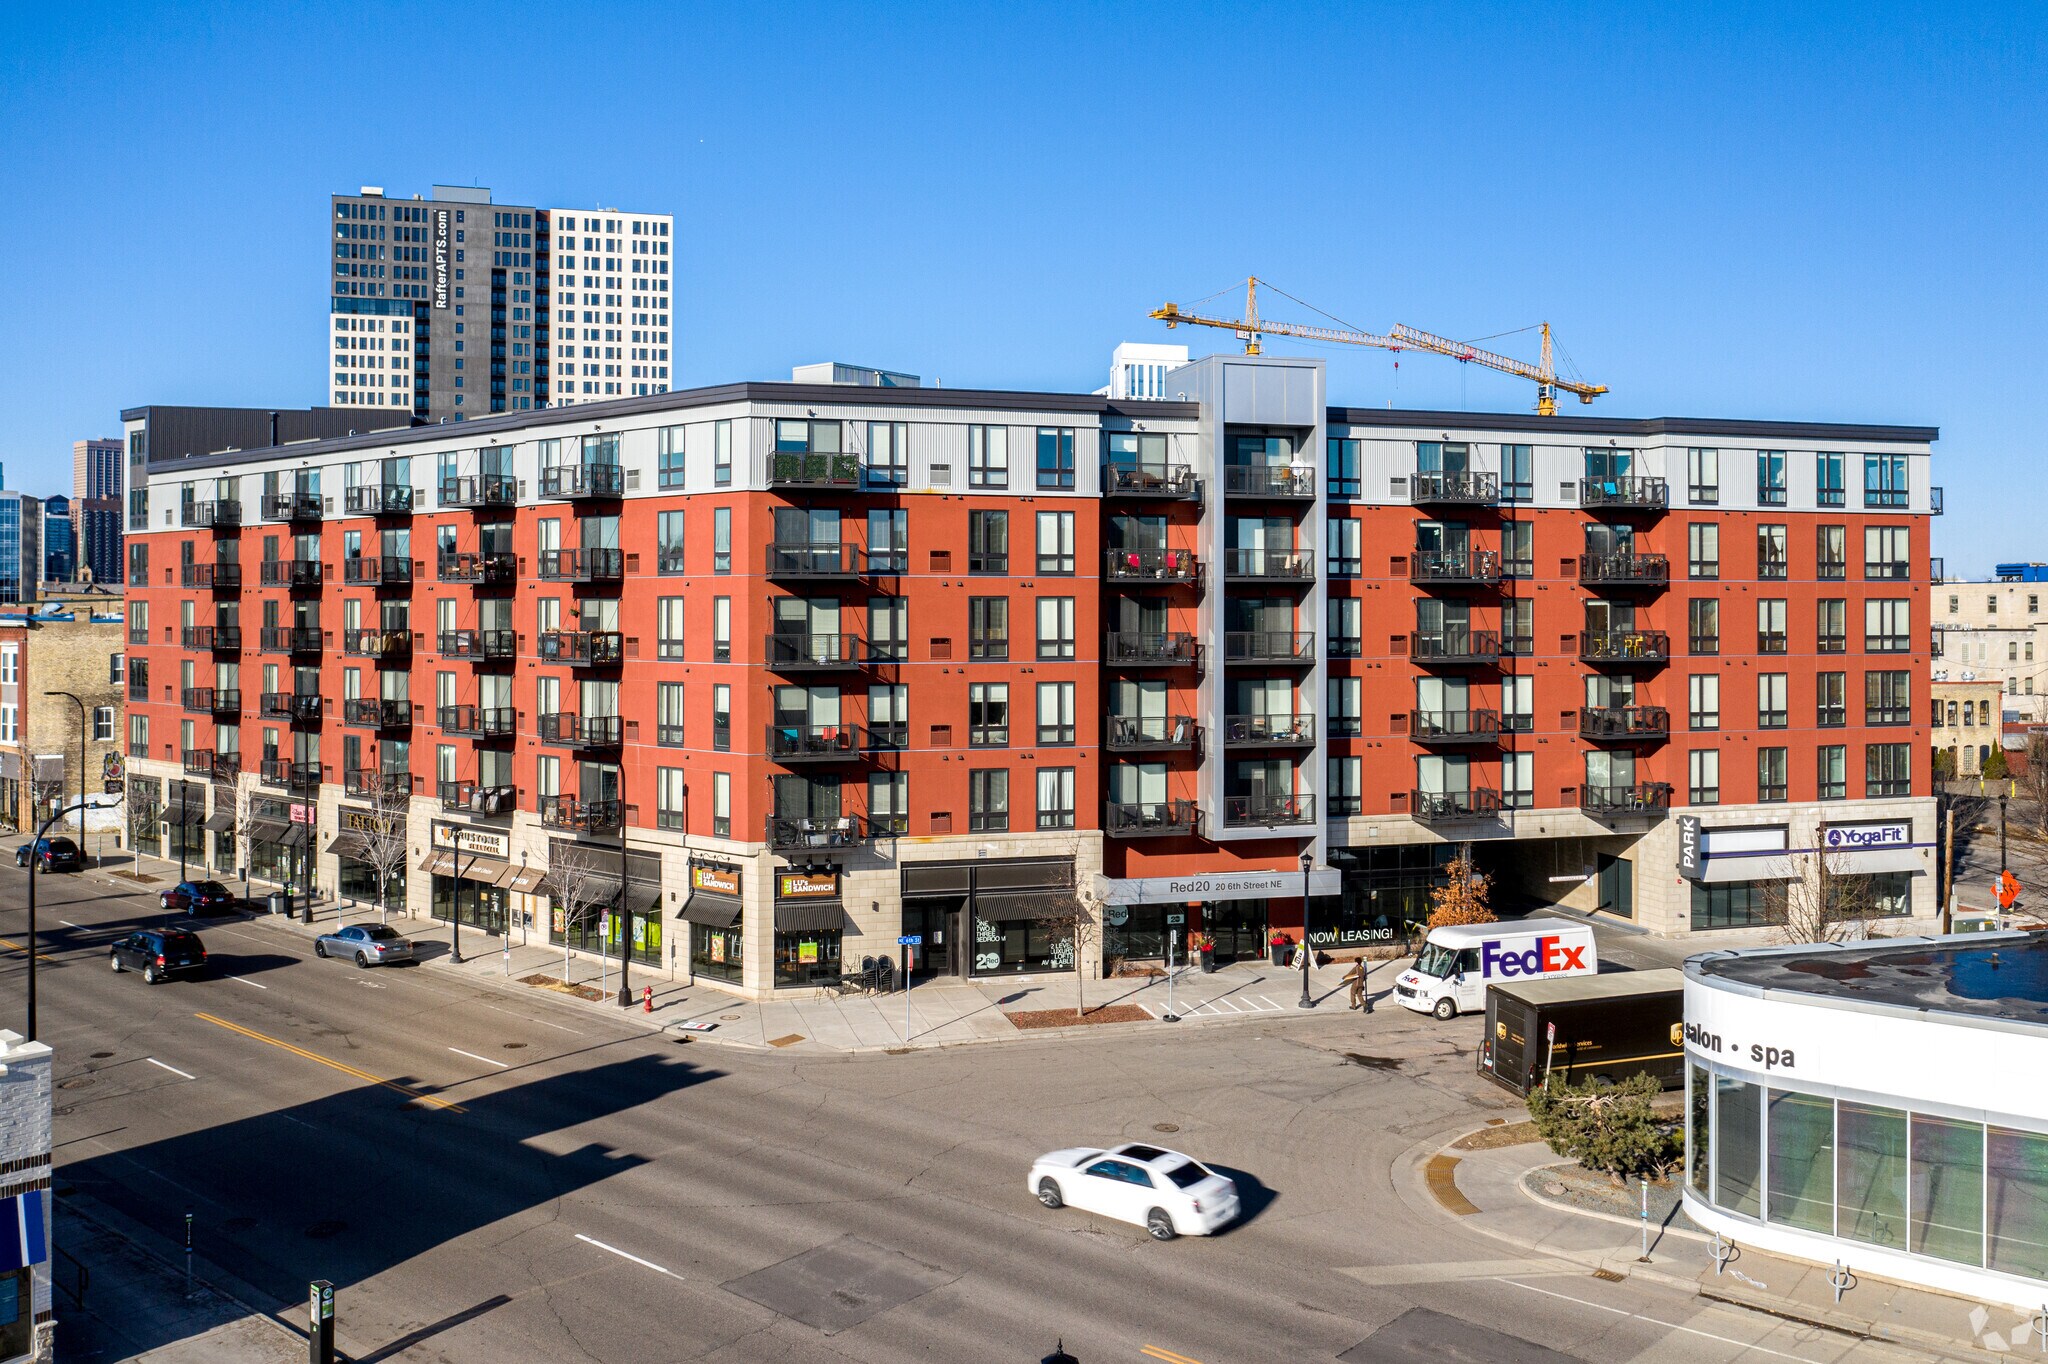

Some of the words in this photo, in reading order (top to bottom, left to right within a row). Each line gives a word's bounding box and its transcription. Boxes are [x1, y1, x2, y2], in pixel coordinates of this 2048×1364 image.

[436, 211, 447, 308] RafterAPTS.com
[450, 828, 500, 846] RUSTONE
[1683, 818, 1694, 868] PARK
[1840, 827, 1902, 846] YogaFit
[703, 879, 735, 891] SANDWICH
[792, 884, 834, 893] SANDWICH
[1170, 880, 1210, 893] Red20
[1215, 883, 1226, 891] 20
[1227, 882, 1241, 890] 6th
[1243, 881, 1268, 889] Street
[1270, 880, 1282, 888] NE
[1108, 909, 1127, 918] Red
[1308, 932, 1337, 943] NOW
[1341, 928, 1393, 942] LEASING!
[1482, 935, 1587, 979] FedEx
[1685, 1022, 1722, 1053] salon
[1750, 1044, 1795, 1070] spa
